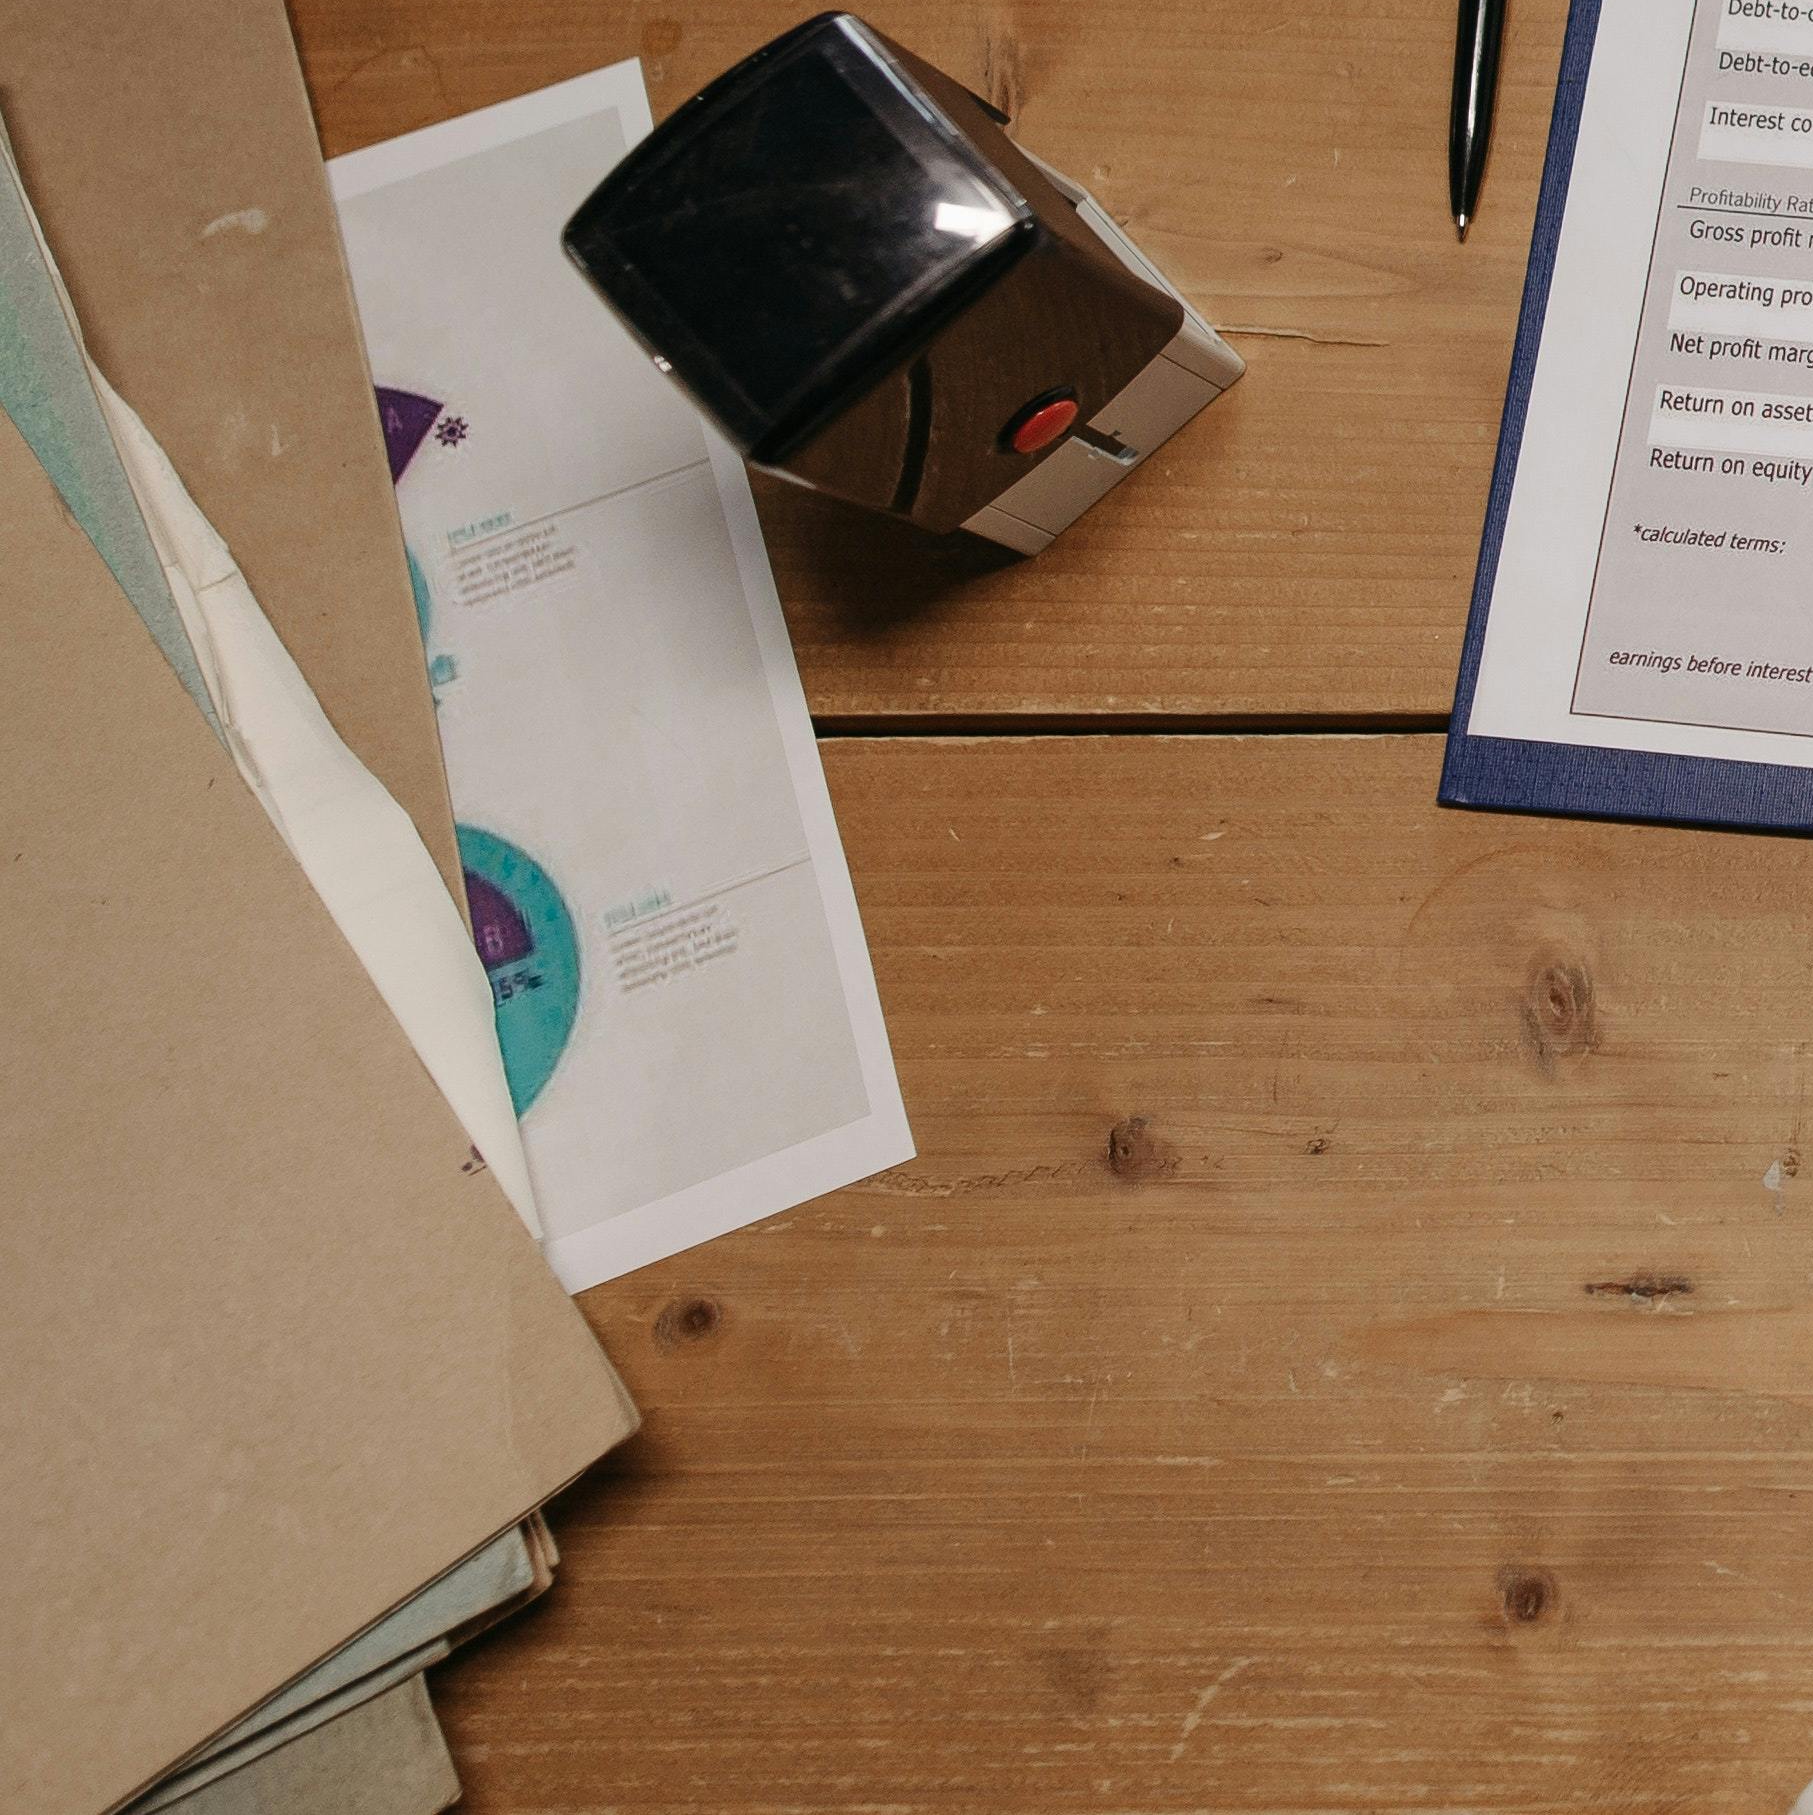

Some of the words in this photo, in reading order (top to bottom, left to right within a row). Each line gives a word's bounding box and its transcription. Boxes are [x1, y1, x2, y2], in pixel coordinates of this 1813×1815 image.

[1708, 105, 1786, 131] Interest
[1688, 186, 1783, 214] Profitability
[1688, 218, 1745, 243] Gross
[1749, 226, 1803, 249] profit
[1679, 274, 1775, 308] Operating
[1669, 332, 1705, 355] Net
[1708, 337, 1763, 360] profit
[1659, 389, 1724, 415] Return
[1730, 399, 1755, 417] on
[1648, 447, 1714, 472] Return
[1720, 457, 1745, 476] on
[1751, 459, 1813, 486] equity
